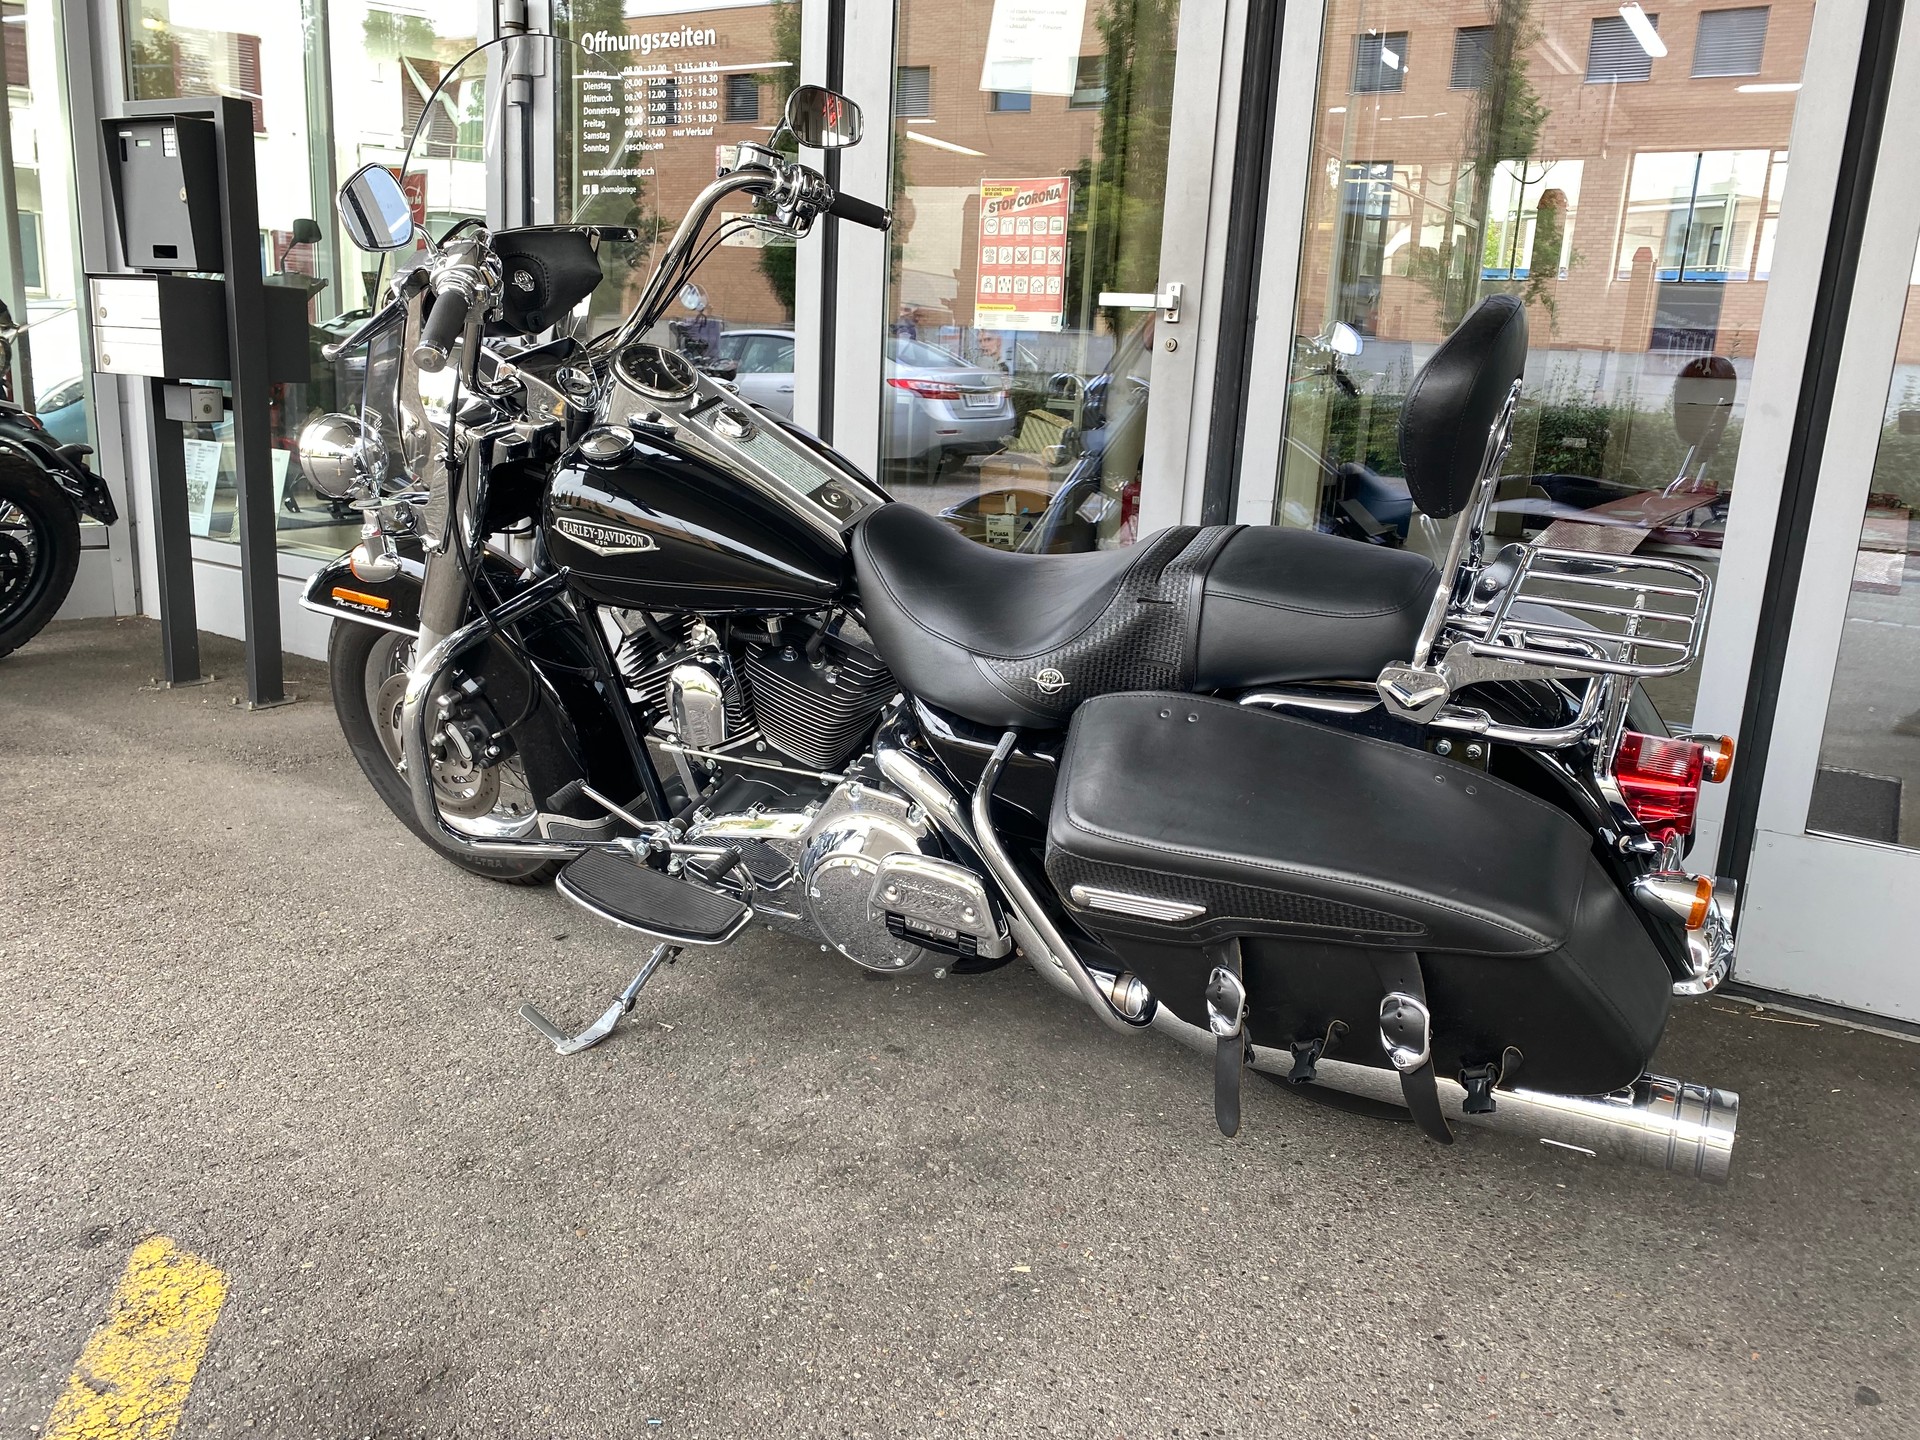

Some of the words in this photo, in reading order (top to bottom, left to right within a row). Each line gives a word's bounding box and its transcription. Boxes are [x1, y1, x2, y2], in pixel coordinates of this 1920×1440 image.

[624, 65, 643, 75] 08.00
[648, 64, 667, 73] 12.00
[674, 62, 693, 71] 13.15
[699, 61, 719, 70] 18.30
[583, 81, 611, 91] Dienstag
[624, 78, 643, 89] 08.00
[648, 77, 667, 86] 12.00
[674, 75, 693, 85] 13.15
[699, 74, 718, 83] 18.30
[583, 93, 613, 103] Mittwoch
[648, 90, 667, 98] 12.00
[674, 88, 693, 97] 13.15
[698, 87, 718, 96] 18.30
[583, 106, 620, 117] Donnerstag
[624, 105, 643, 113] 08.00
[648, 103, 667, 111] 12.00
[674, 101, 693, 110] 13.15
[698, 100, 718, 110] 18.30
[583, 119, 606, 129] Freitag
[624, 117, 643, 126] 08.00
[648, 115, 667, 124] 12.00
[674, 114, 693, 123] 13.15
[698, 113, 718, 122] 18.30
[583, 131, 610, 142] Samstag
[624, 129, 643, 139] 09.00
[648, 128, 666, 137] 14.00
[673, 128, 685, 136] nur
[685, 126, 714, 136] Verkauf
[583, 143, 609, 153] Sonntag
[624, 141, 664, 154] geschlossen
[582, 166, 655, 178] www.shamalgarage.ch
[600, 184, 637, 195] shamalgarage
[988, 198, 1016, 213] STOP
[1017, 187, 1061, 208] CORONA
